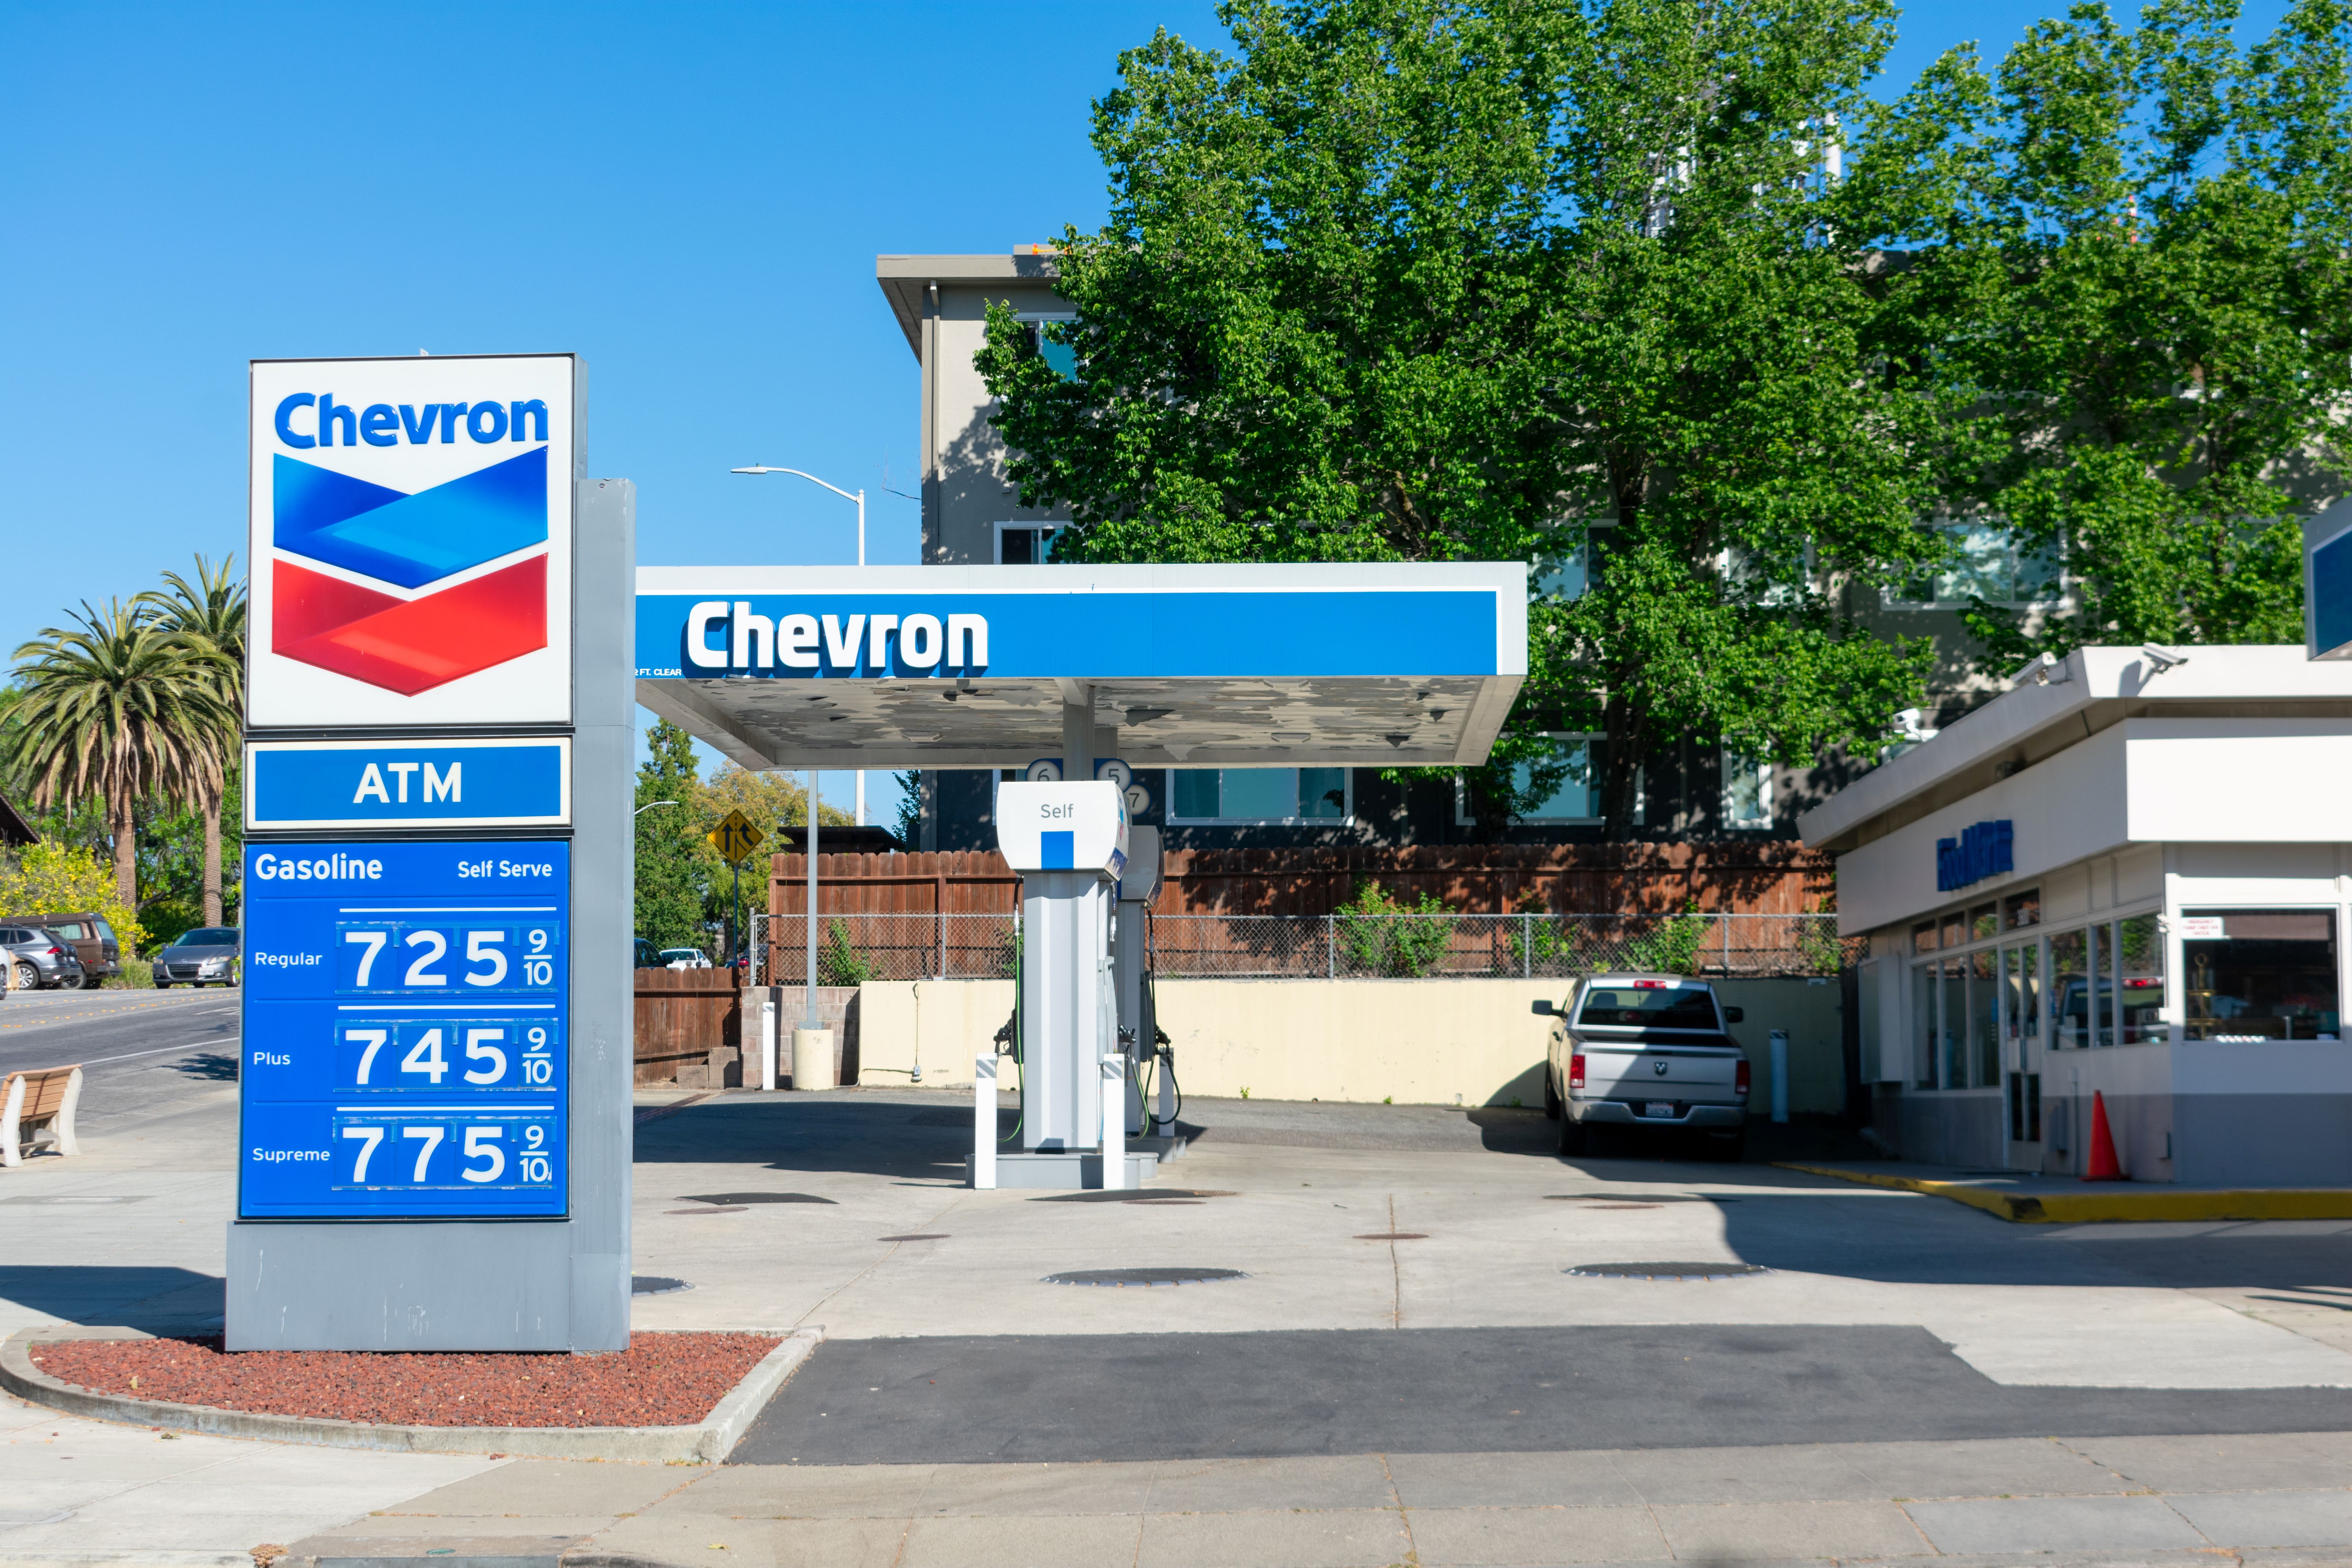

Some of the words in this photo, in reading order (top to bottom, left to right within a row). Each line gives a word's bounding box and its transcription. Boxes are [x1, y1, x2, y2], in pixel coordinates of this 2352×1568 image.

[274, 392, 548, 449] Chevron
[687, 601, 989, 668] Chevron
[353, 762, 462, 804] ATM
[1037, 768, 1050, 781] 6
[1108, 768, 1120, 785] 5
[1129, 793, 1140, 808] 7
[1041, 803, 1074, 818] Self
[256, 853, 383, 880] Gasoline
[458, 860, 493, 878] Self
[499, 860, 552, 877] Serve
[255, 952, 322, 969] Regular
[254, 1052, 291, 1065] Plus
[253, 1147, 330, 1163] Supreme
